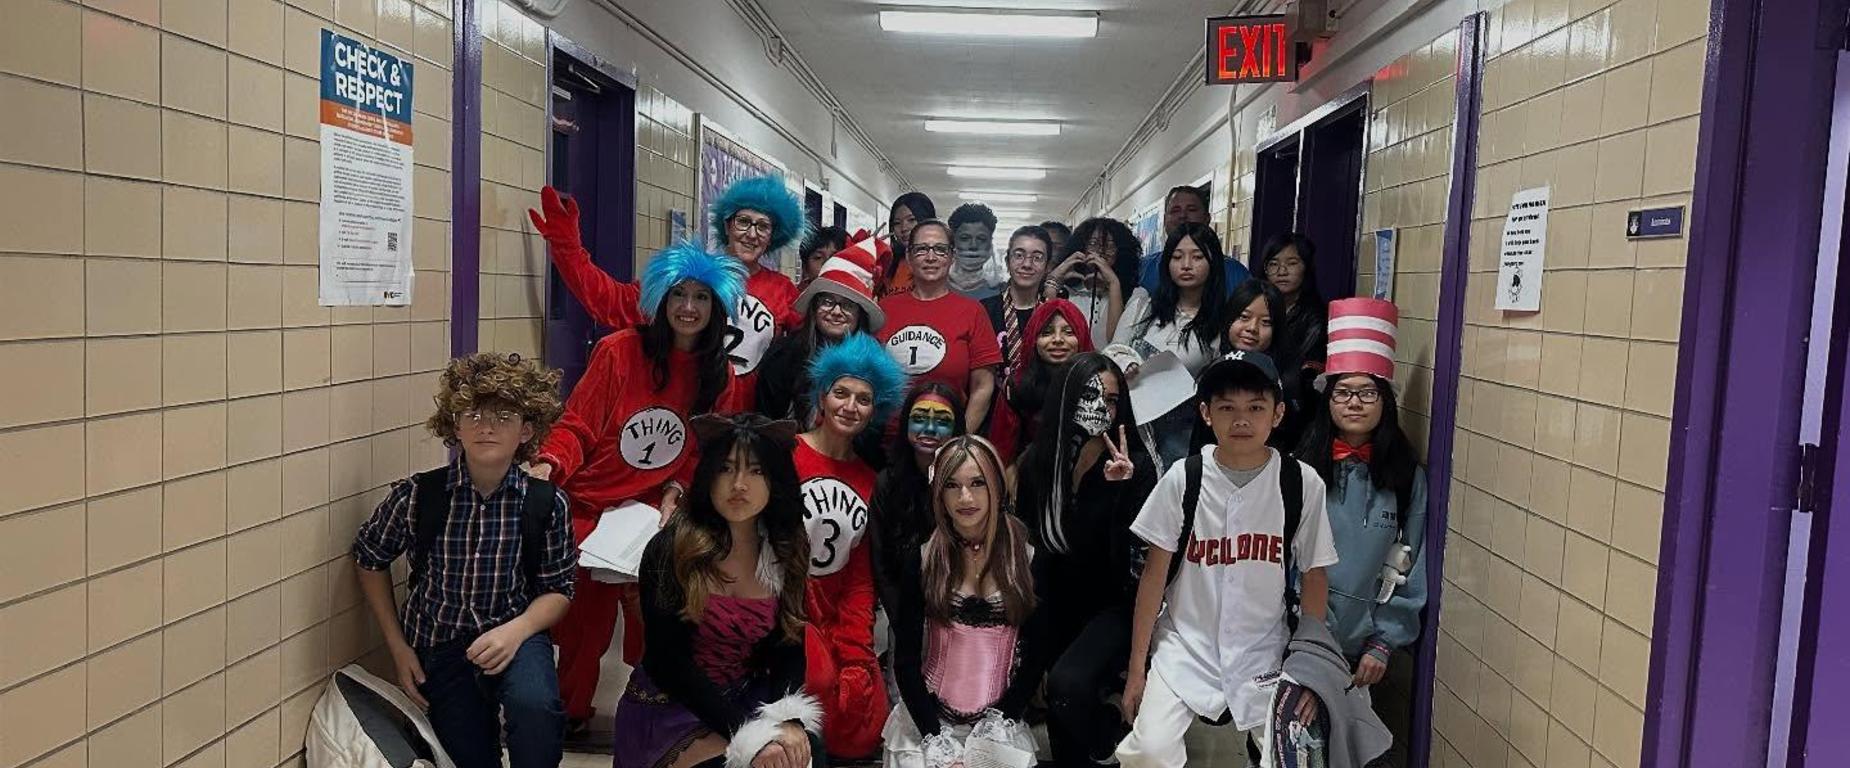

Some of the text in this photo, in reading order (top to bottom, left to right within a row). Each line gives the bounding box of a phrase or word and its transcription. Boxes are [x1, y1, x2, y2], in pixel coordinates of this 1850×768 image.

[335, 42, 401, 86] CHECK &
[1219, 24, 1286, 78] EXIT
[335, 72, 403, 115] RESPECT
[722, 325, 749, 367] 2
[891, 331, 944, 350] GUIDANCE
[625, 417, 683, 445] THING
[638, 441, 656, 464] 1
[811, 519, 840, 568] 3
